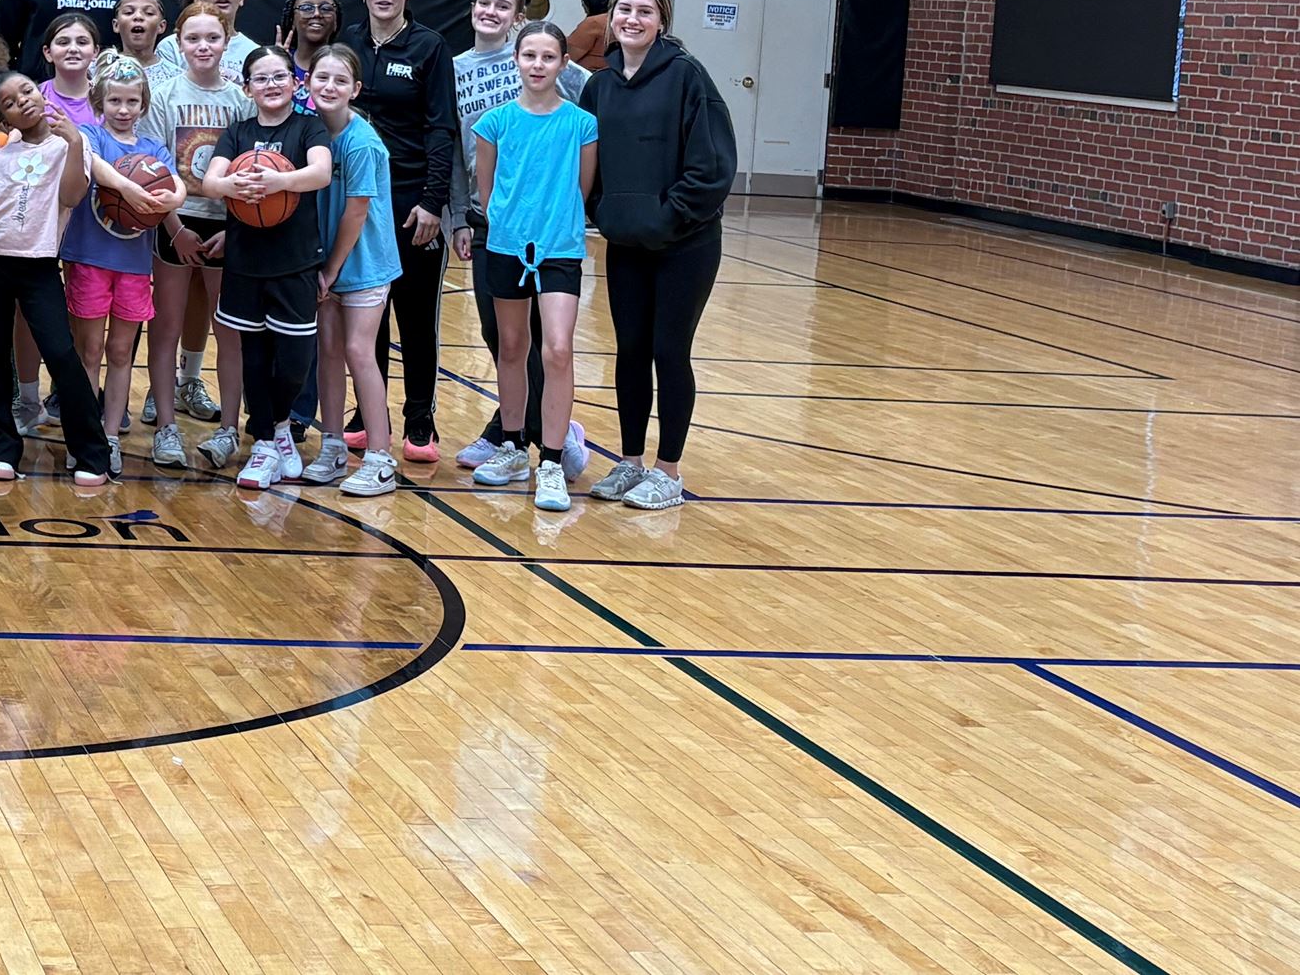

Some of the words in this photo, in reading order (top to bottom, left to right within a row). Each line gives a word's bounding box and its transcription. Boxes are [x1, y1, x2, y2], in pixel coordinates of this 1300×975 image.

[708, 6, 735, 15] NOTICE
[386, 62, 414, 80] HER
[457, 70, 473, 86] MY
[457, 85, 474, 101] MY
[457, 99, 486, 118] YOUR
